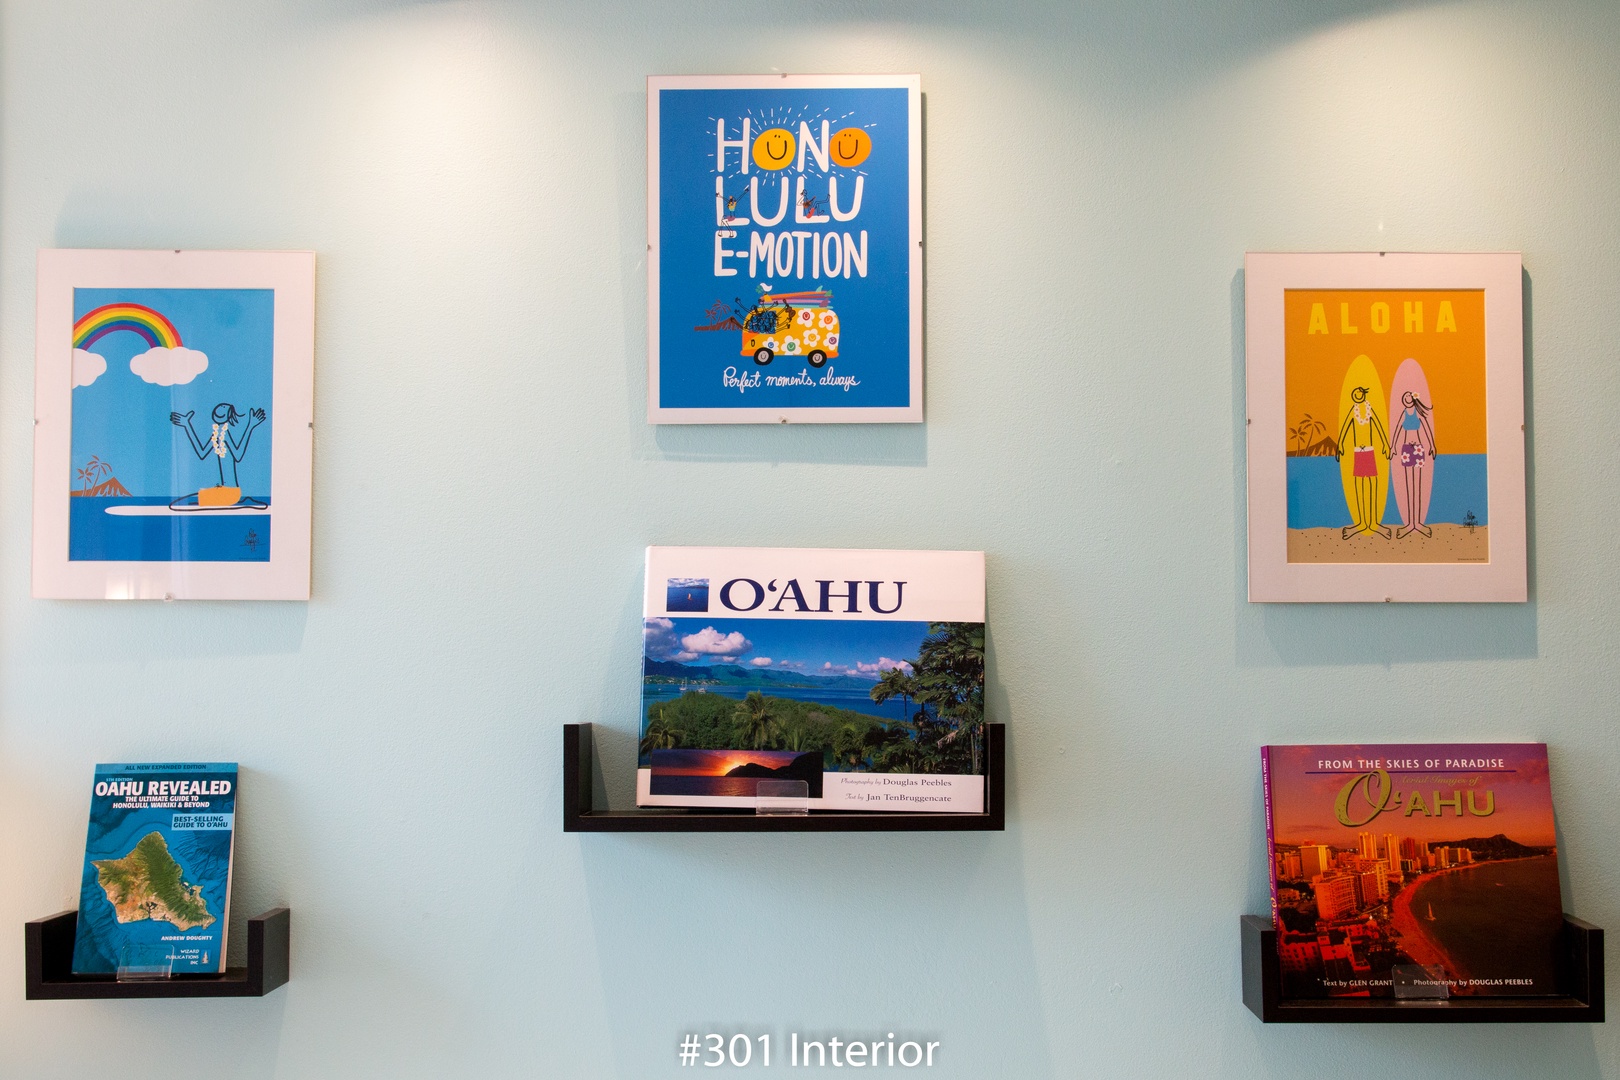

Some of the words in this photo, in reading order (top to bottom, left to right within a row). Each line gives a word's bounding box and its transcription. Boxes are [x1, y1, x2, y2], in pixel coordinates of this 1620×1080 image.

[716, 117, 872, 175] HONO
[715, 176, 864, 227] LULU
[714, 230, 868, 279] E-MOTION
[1308, 300, 1457, 335] ALOHA
[723, 366, 761, 394] Perfect
[765, 368, 817, 387] moments,
[819, 366, 861, 392] always
[719, 578, 908, 614] O'AHU
[1318, 760, 1353, 769] FROM
[1358, 760, 1381, 769] THE
[1386, 759, 1420, 768] SKIES
[1425, 759, 1440, 768] OF
[1445, 758, 1505, 768] PARADISE
[95, 782, 143, 796] OAHU
[148, 780, 232, 796] REVEALED
[883, 778, 918, 787] Douglas
[921, 779, 952, 787] Peebles
[865, 793, 881, 802] Jan
[883, 794, 952, 803] TenBruggencate
[1339, 979, 1347, 987] by
[1413, 979, 1457, 987] Photography
